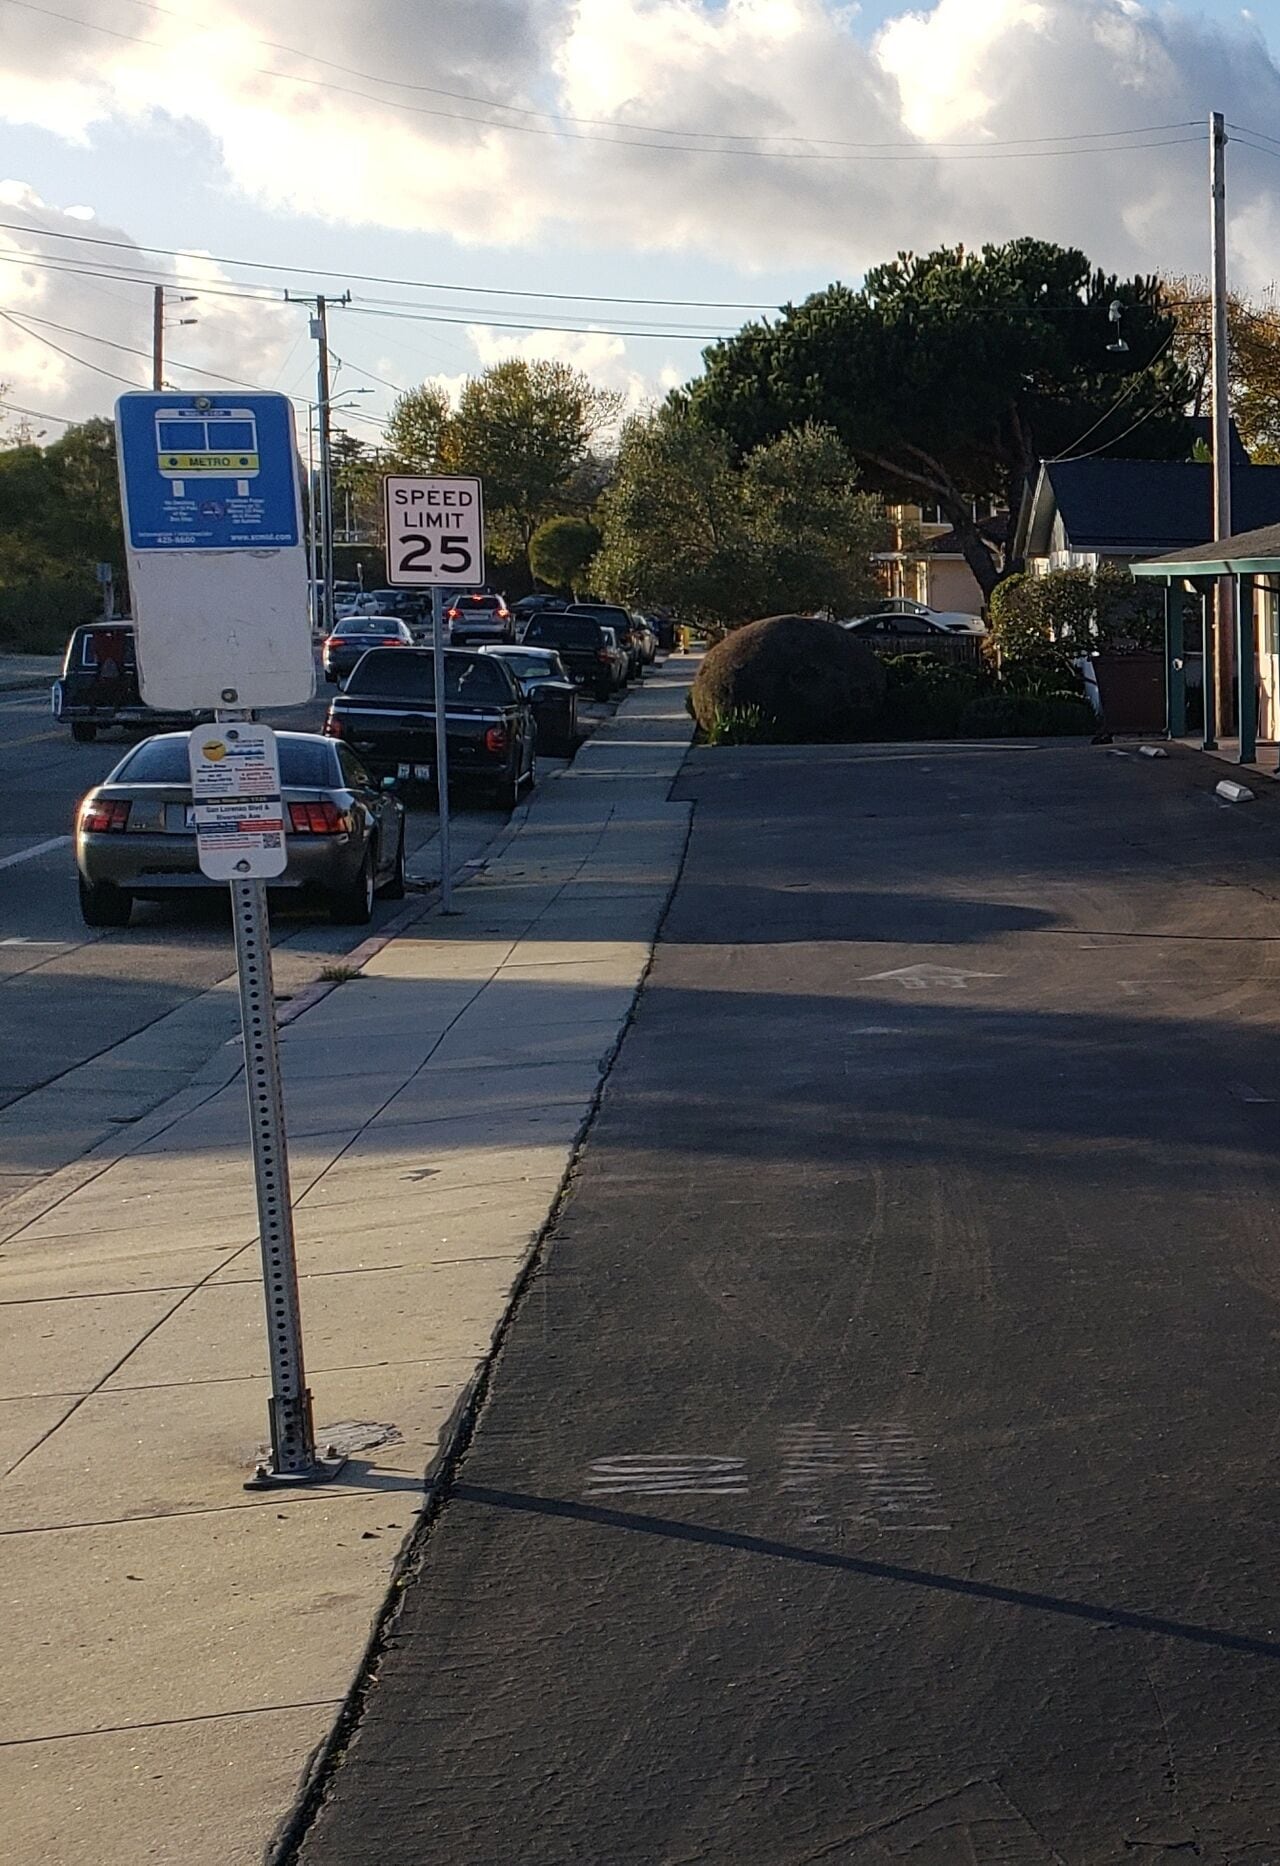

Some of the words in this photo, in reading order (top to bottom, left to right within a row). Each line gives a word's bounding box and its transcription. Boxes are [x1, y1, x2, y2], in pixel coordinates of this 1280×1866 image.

[189, 457, 231, 467] METRO
[395, 489, 473, 507] SPEED
[404, 511, 464, 529] LIMIT
[398, 534, 472, 573] 25
[581, 1454, 749, 1496] NO
